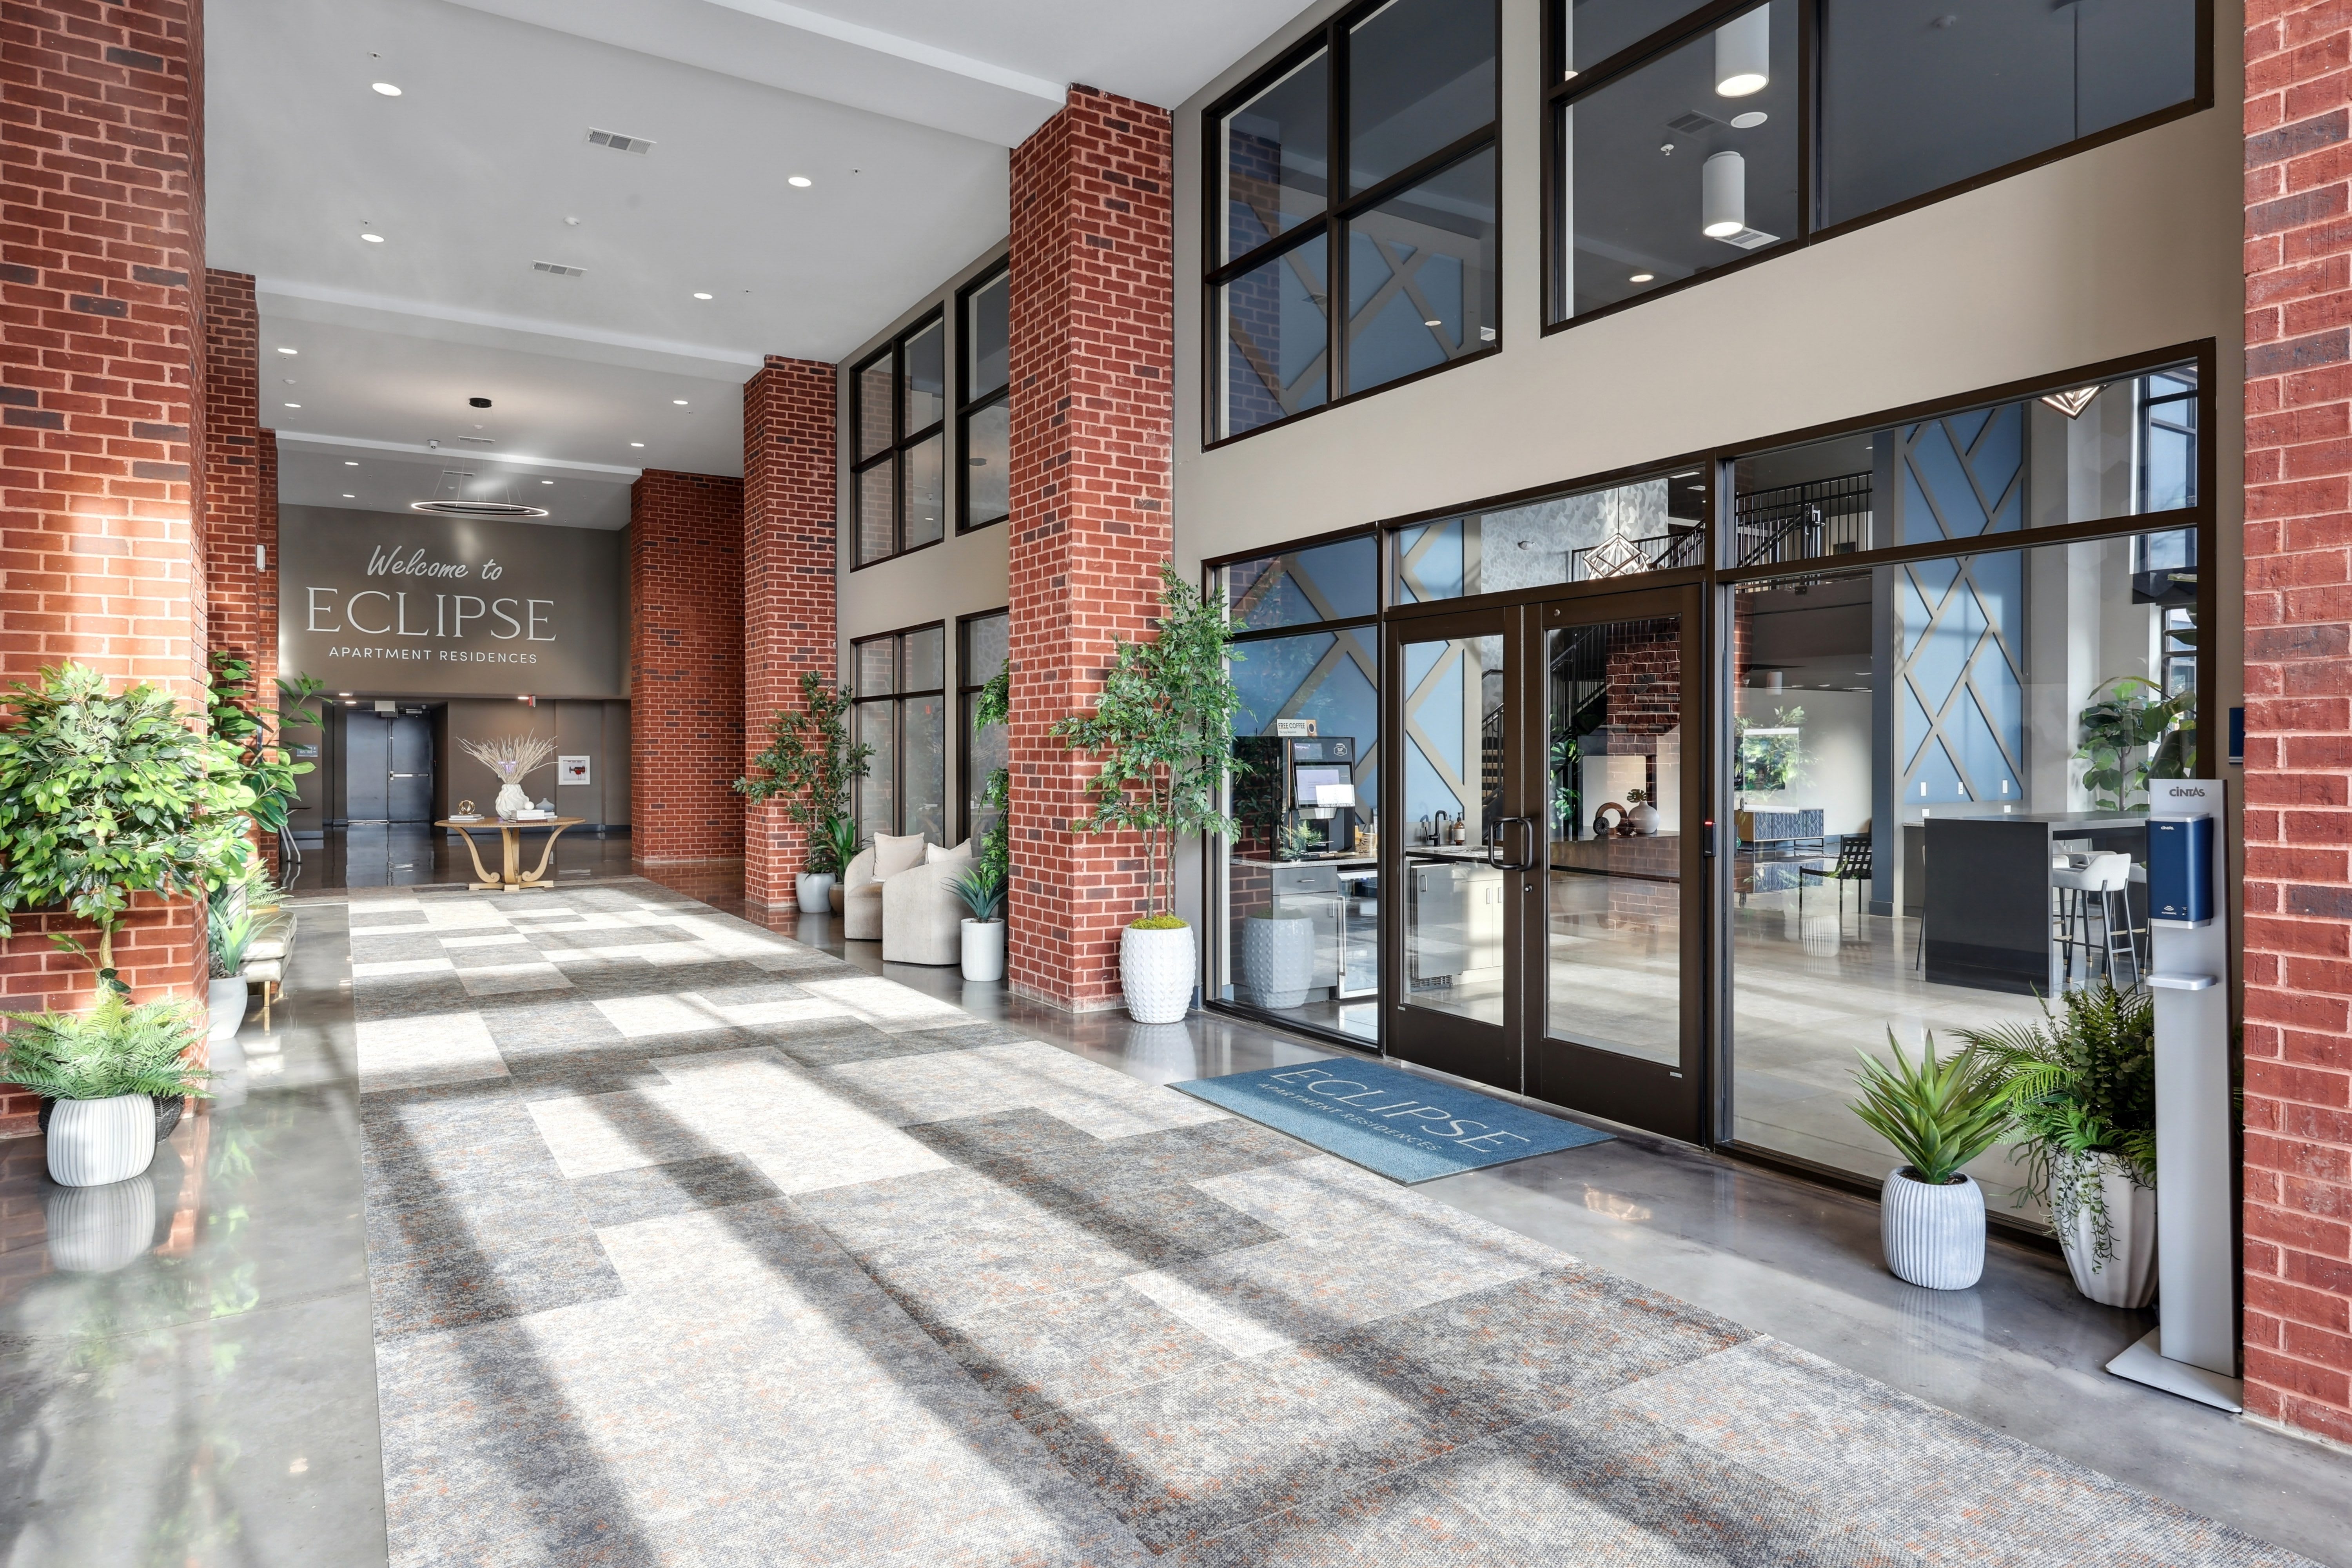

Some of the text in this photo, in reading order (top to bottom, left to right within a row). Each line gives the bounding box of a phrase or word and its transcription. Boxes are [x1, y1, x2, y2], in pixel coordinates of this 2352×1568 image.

[367, 545, 503, 580] Welcome to
[306, 587, 557, 641] ECLIPSE
[329, 646, 537, 664] APARTMENT RESIDENCES
[1257, 1083, 1442, 1150] APARTMENT RESIDENCES
[1270, 1069, 1531, 1152] ECLIPSE
